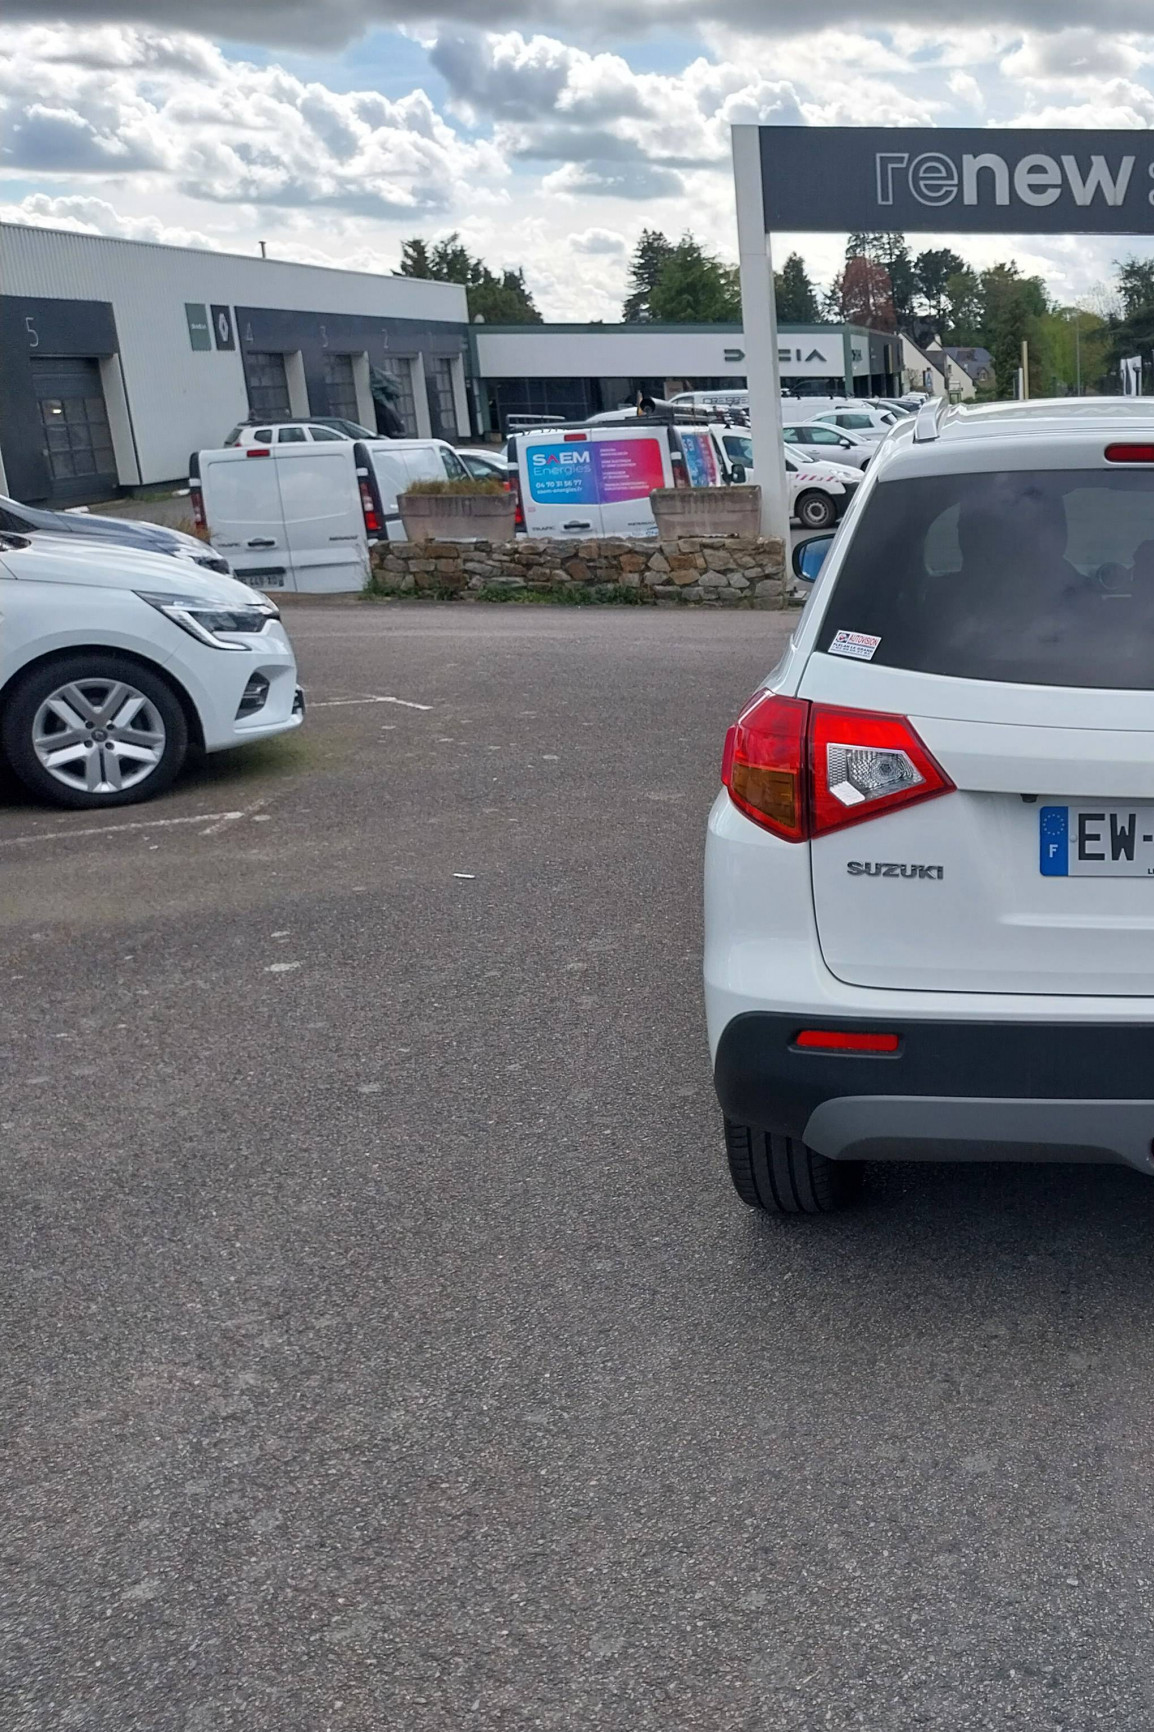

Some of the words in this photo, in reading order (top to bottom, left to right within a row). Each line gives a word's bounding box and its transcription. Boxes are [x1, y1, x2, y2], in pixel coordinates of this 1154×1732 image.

[875, 151, 1137, 207] renew
[25, 317, 39, 347] 5
[723, 349, 827, 362] DCIA
[532, 451, 591, 466] SAEM
[533, 464, 592, 476] Energies
[1049, 844, 1059, 858] F
[847, 861, 944, 880] SUZUKI
